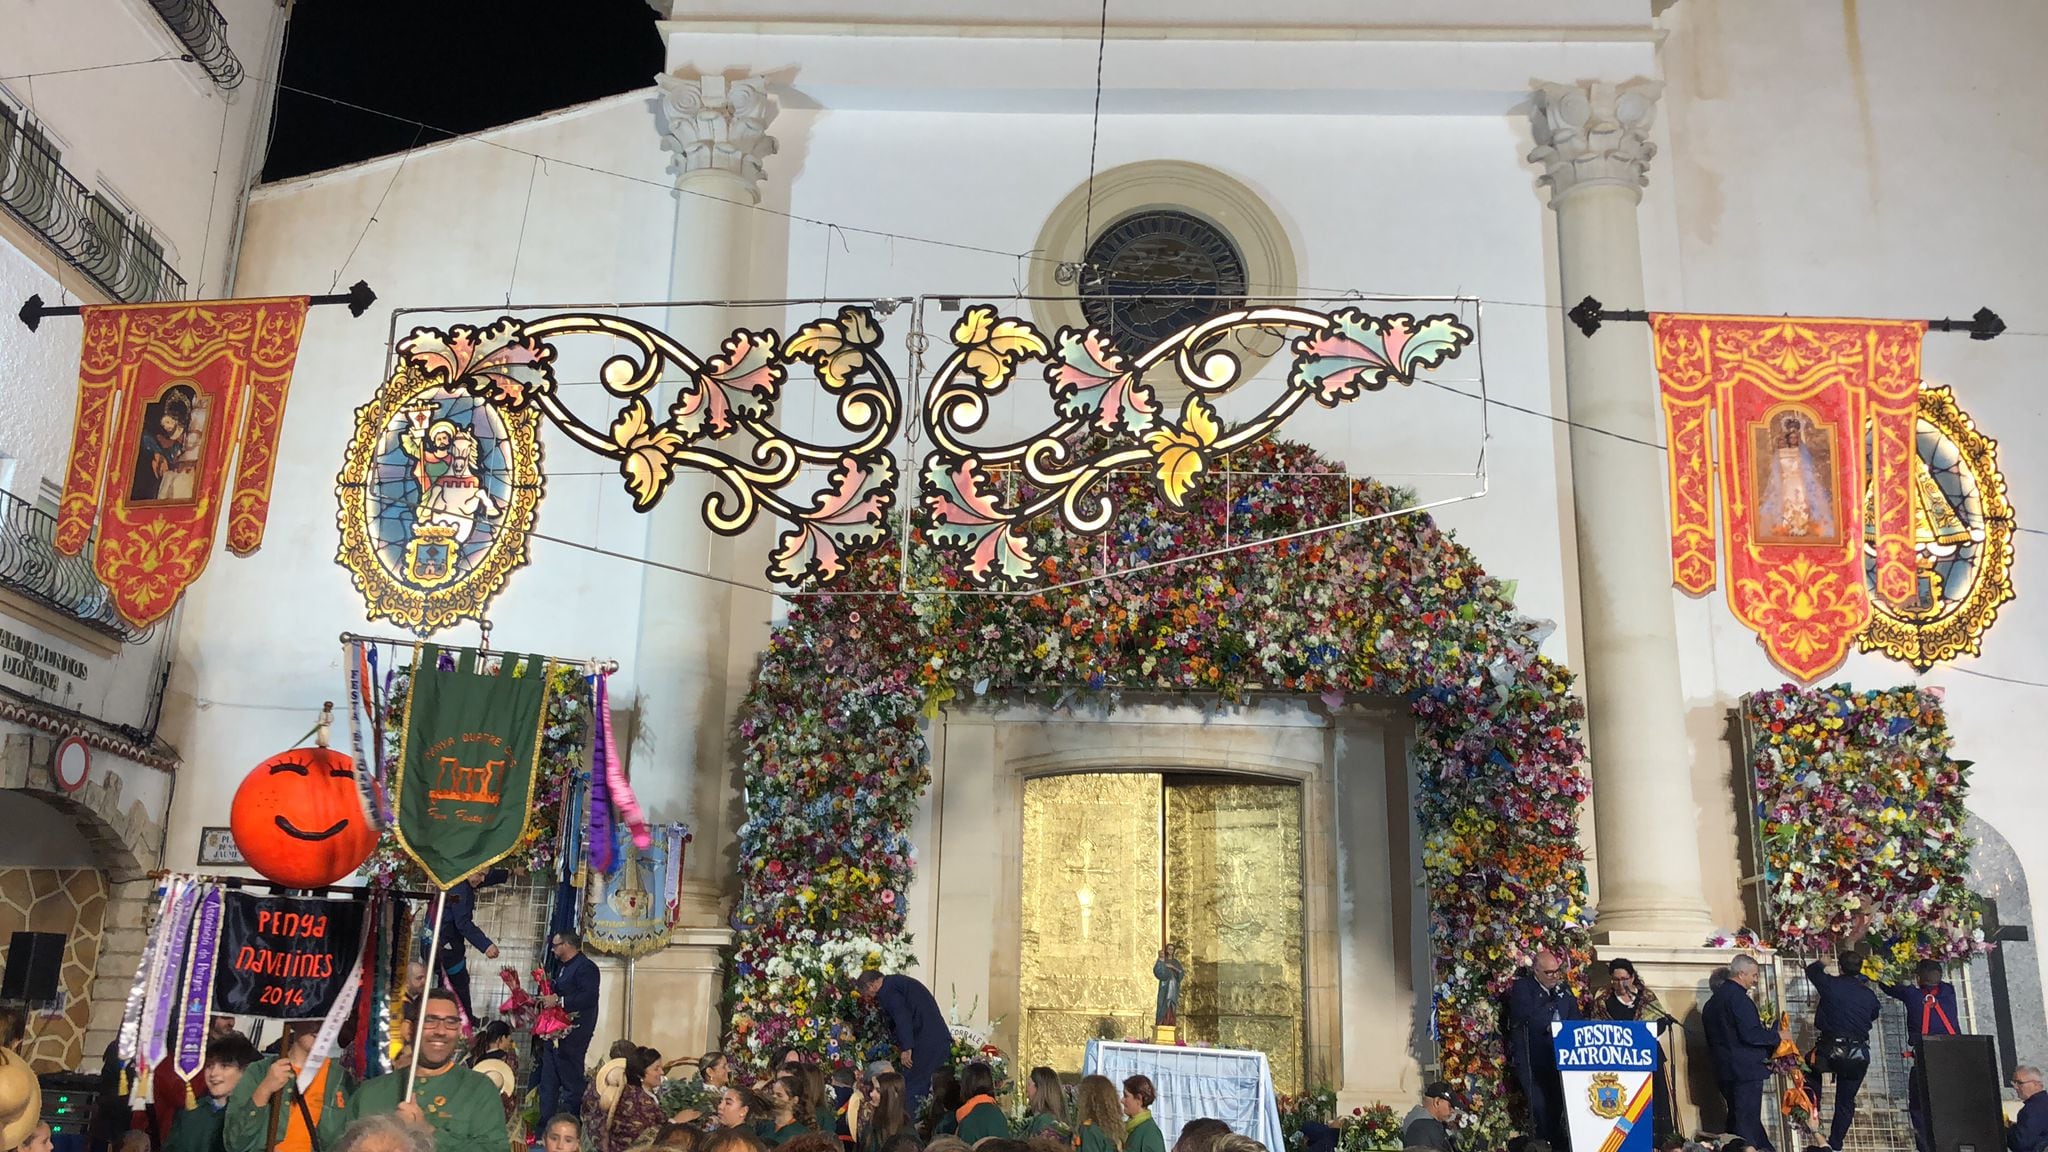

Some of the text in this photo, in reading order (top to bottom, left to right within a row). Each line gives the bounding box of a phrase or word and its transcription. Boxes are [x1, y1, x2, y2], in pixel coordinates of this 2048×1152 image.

[259, 985, 304, 1007] 2014
[1573, 1023, 1634, 1048] FESTES
[1558, 1045, 1653, 1066] PATRONALS
